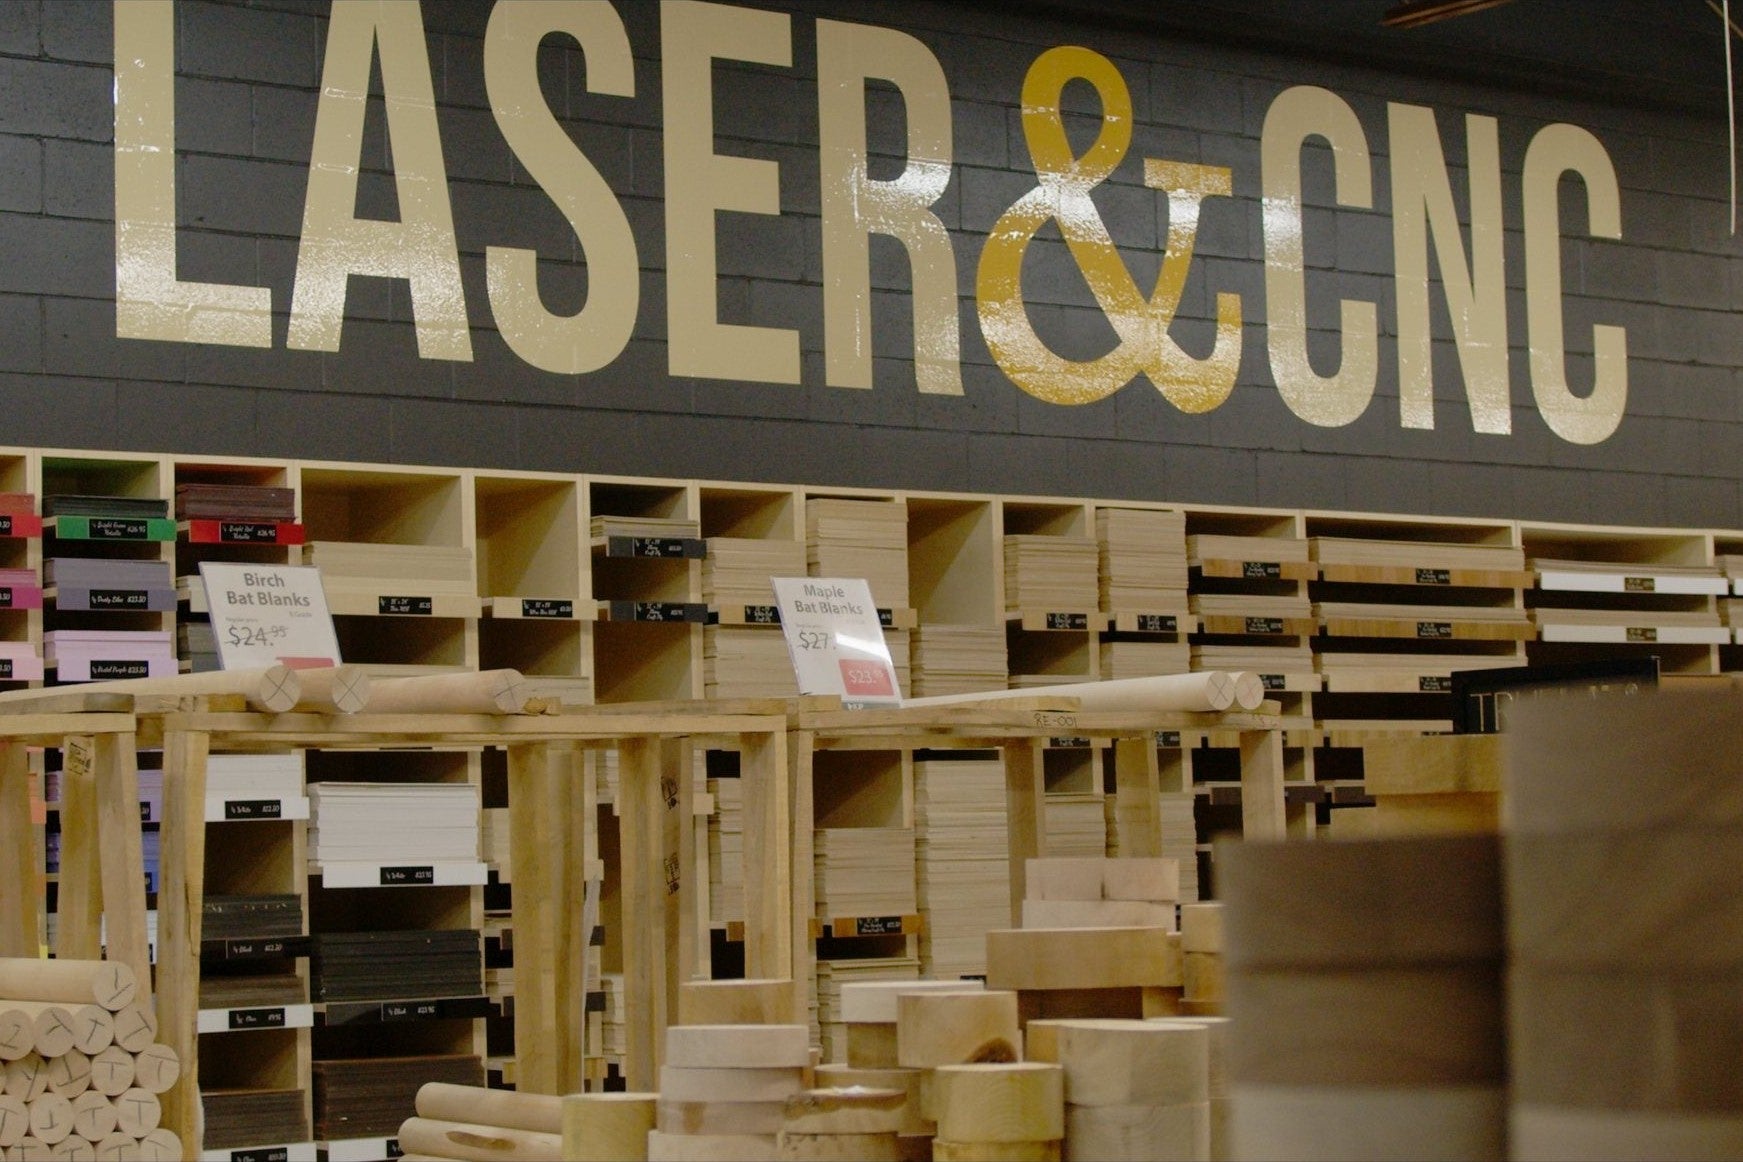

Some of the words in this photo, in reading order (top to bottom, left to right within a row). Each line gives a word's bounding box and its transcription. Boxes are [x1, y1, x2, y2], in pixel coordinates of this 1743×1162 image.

[113, 0, 964, 397] LASER
[977, 45, 1243, 414] &
[1261, 85, 1628, 446] CNC
[243, 573, 285, 588] Birch
[226, 591, 256, 606] Bat
[257, 591, 311, 607] Blanks
[803, 584, 845, 600] Maple
[795, 600, 817, 614] Bat
[819, 602, 865, 616] Blanks
[227, 624, 287, 647] $24.95
